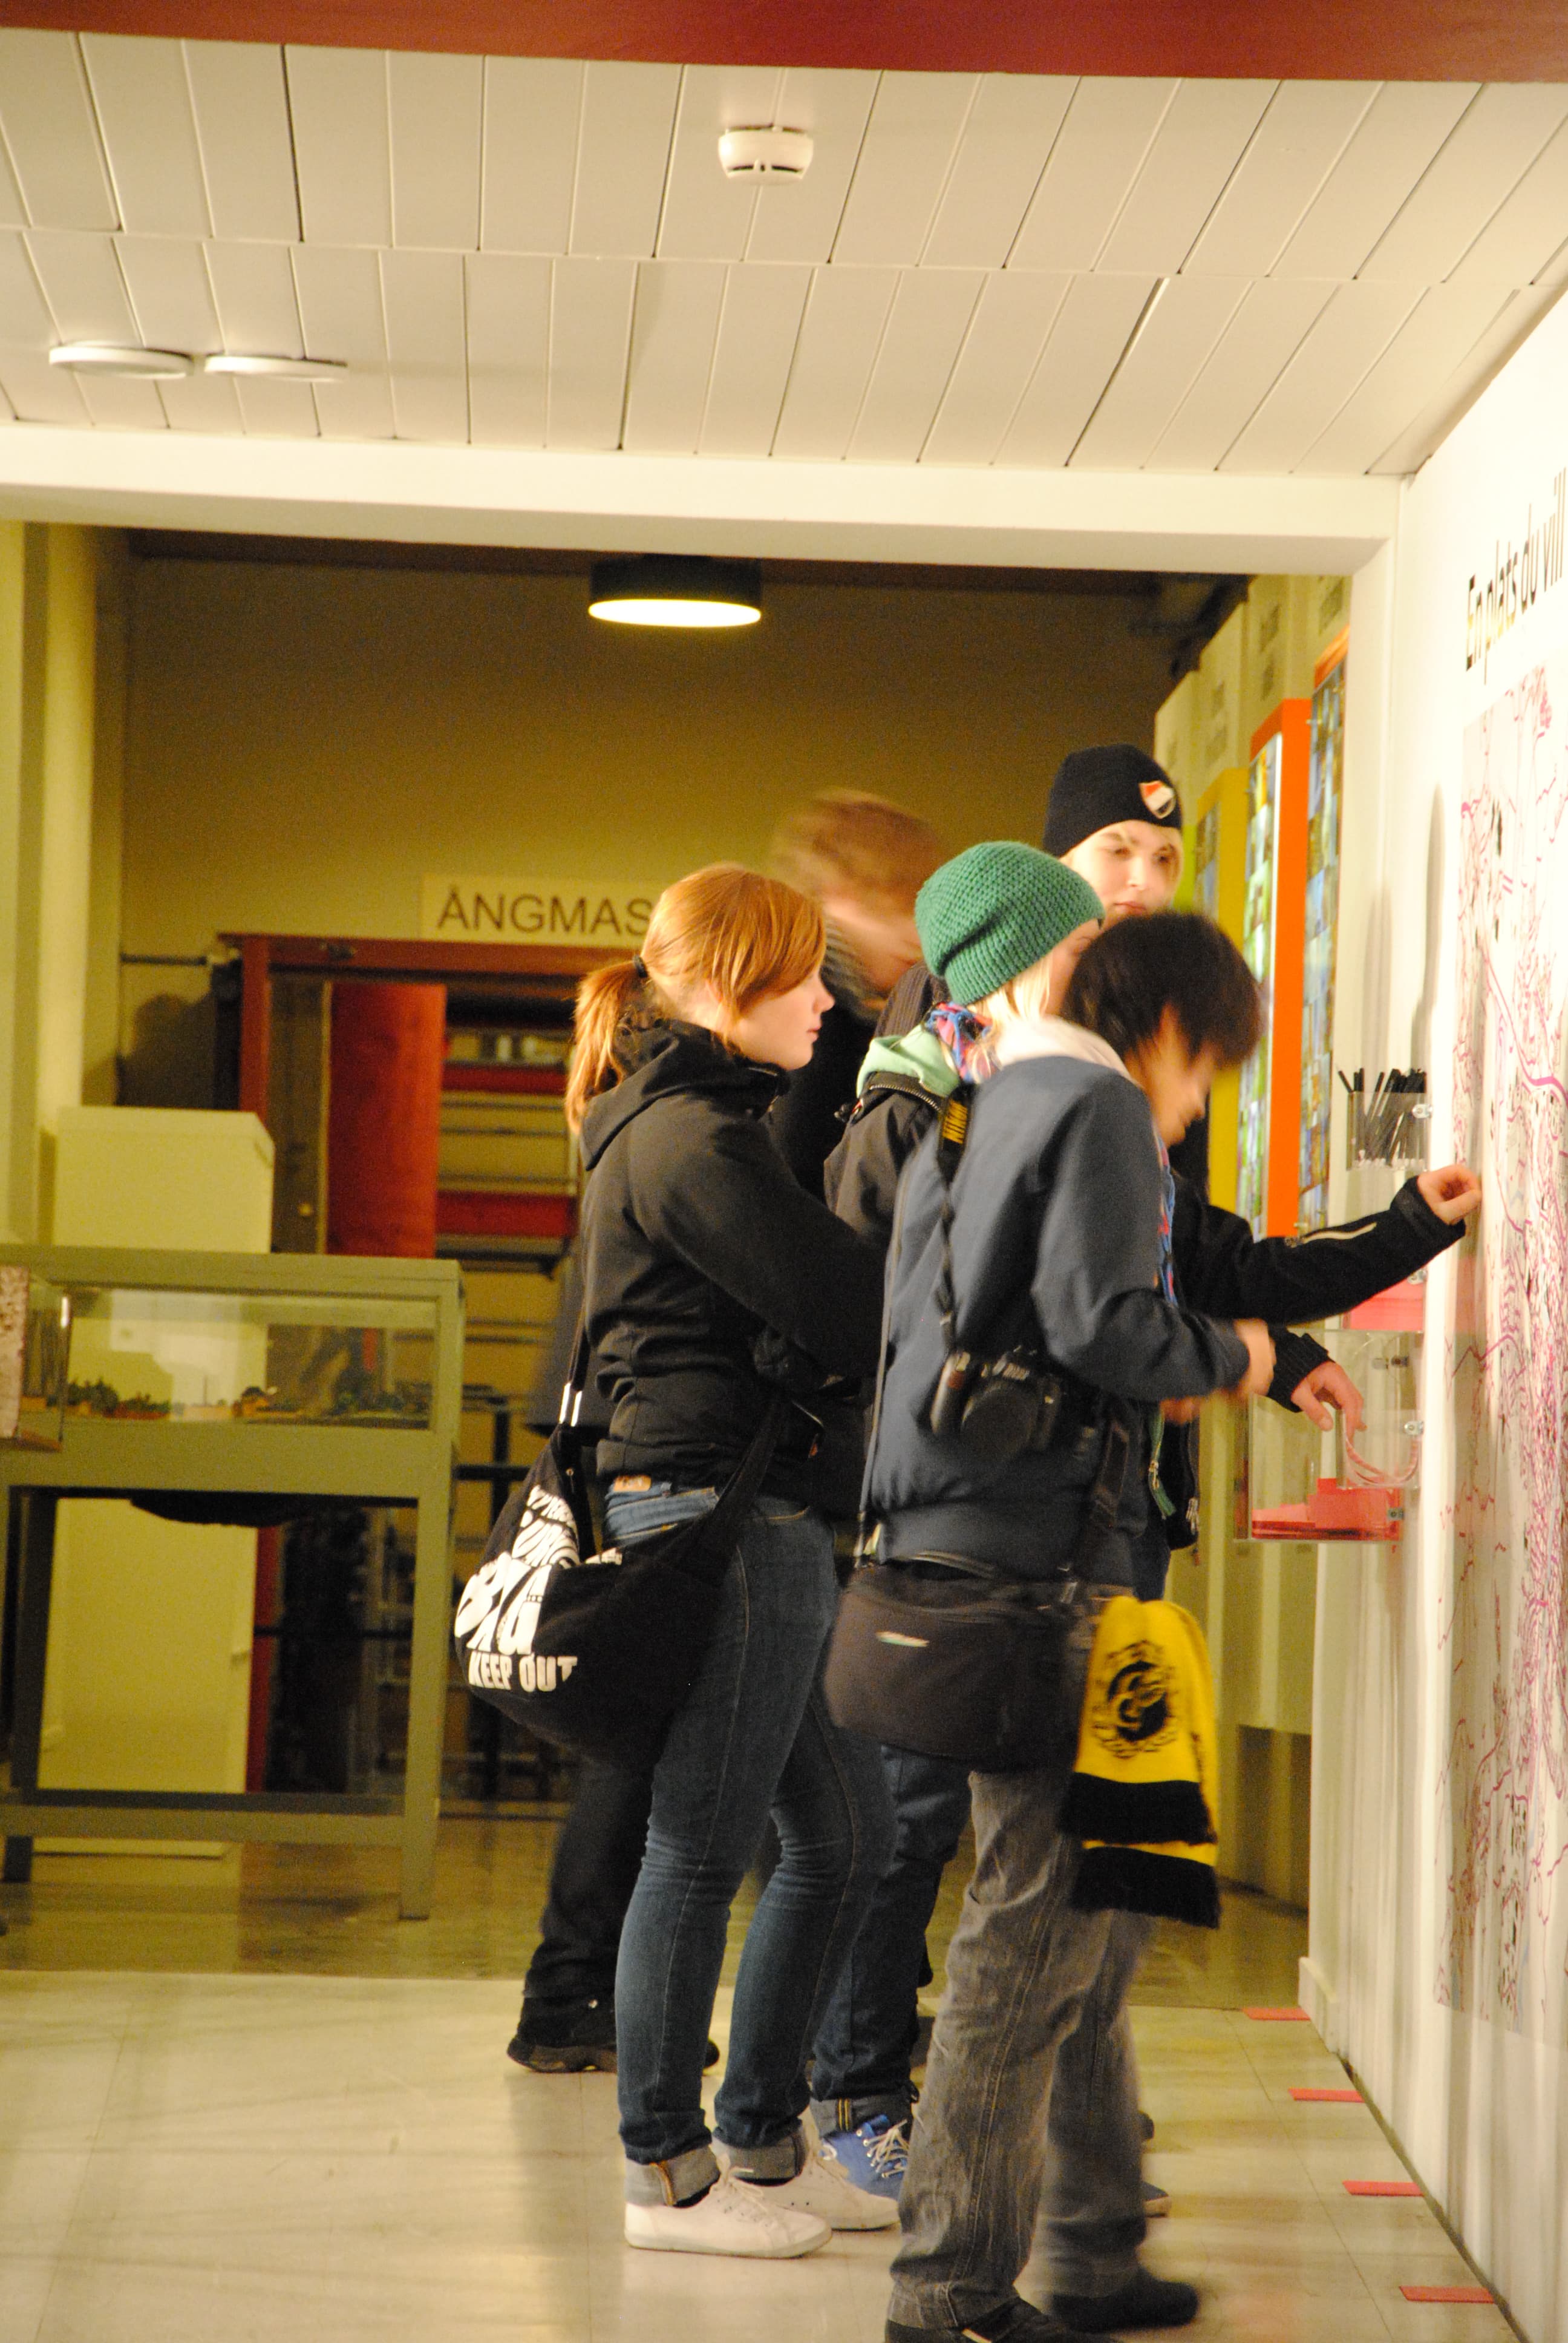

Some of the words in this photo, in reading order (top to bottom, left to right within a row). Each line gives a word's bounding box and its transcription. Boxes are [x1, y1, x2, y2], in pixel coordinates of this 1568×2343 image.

[1466, 573, 1482, 672] En
[1484, 540, 1518, 686] plats
[1521, 503, 1540, 615] du
[468, 1650, 512, 1690] KEEP
[519, 1654, 578, 1693] OUT
